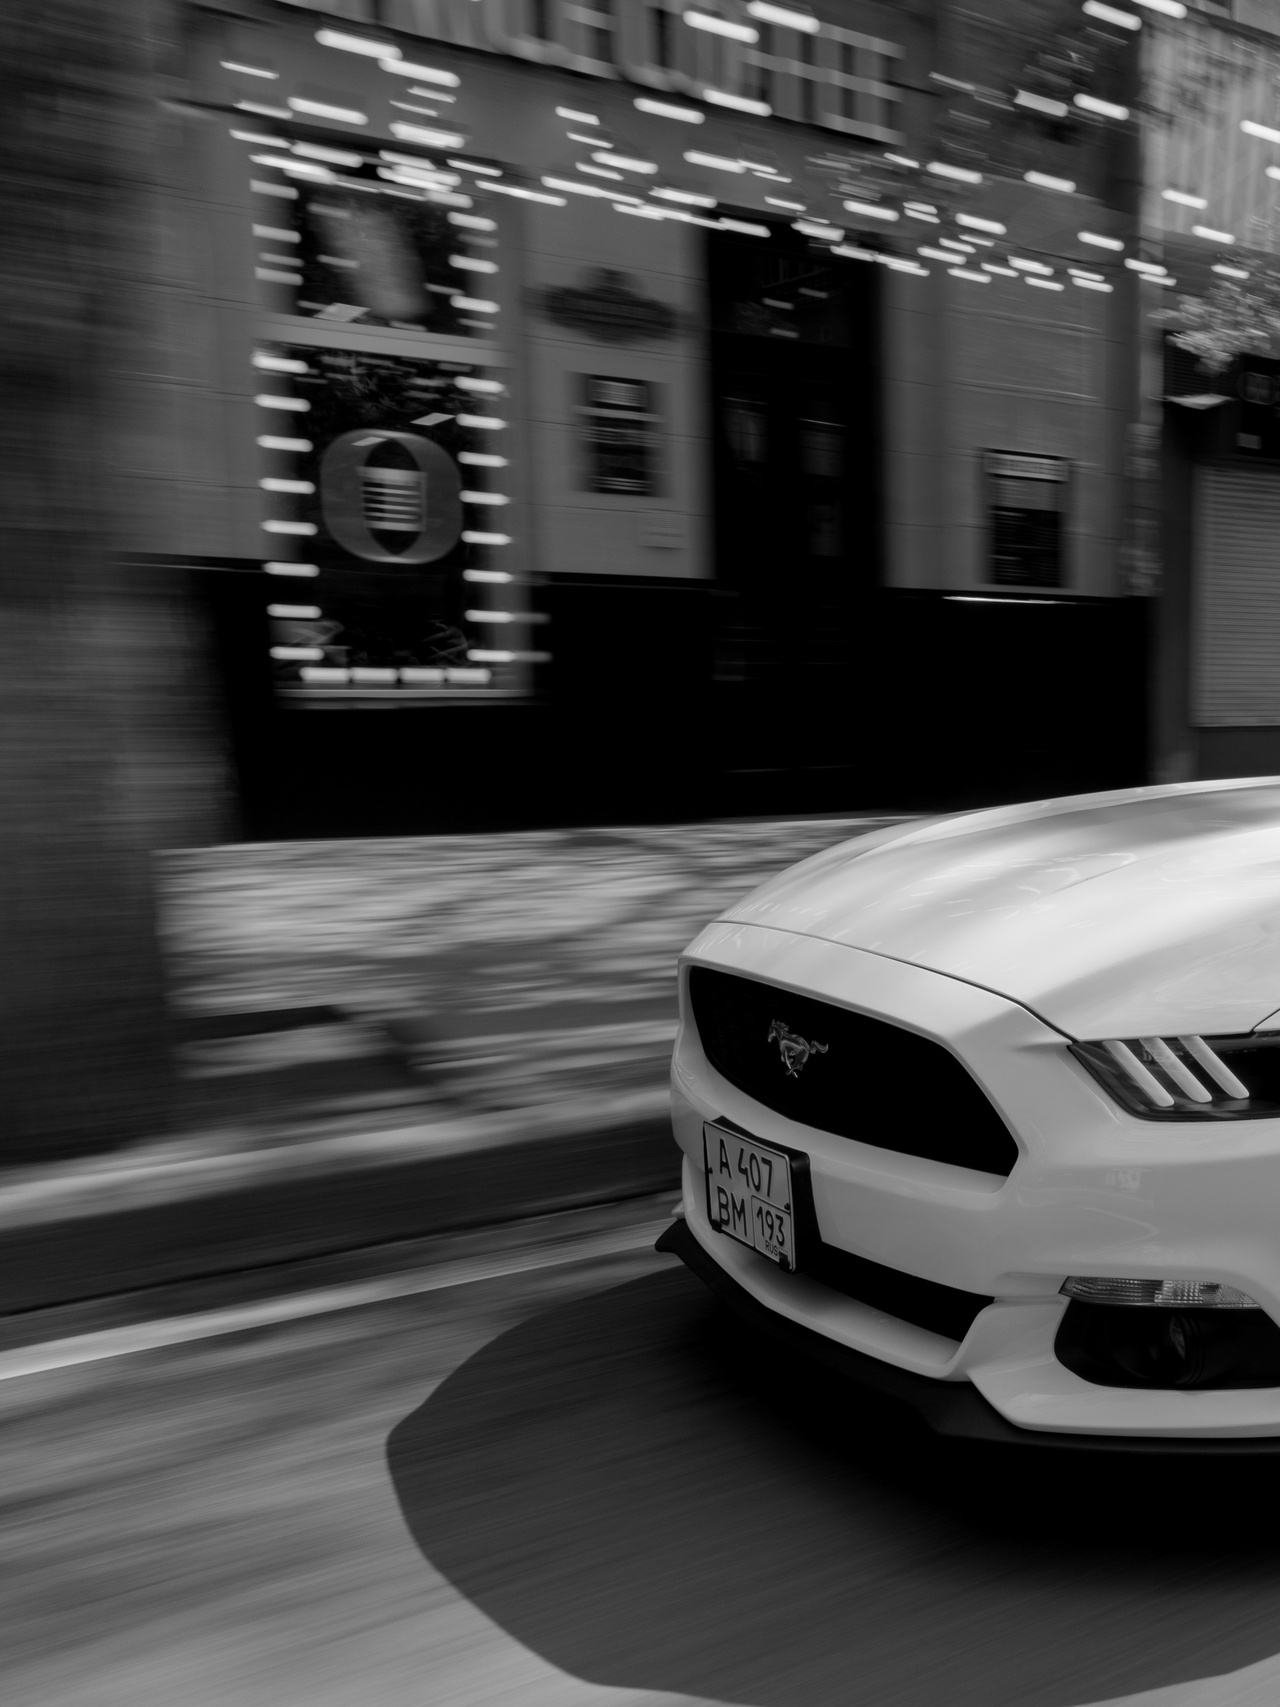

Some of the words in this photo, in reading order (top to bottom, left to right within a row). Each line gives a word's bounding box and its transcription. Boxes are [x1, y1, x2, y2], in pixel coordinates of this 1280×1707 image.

[720, 1138, 731, 1179] A
[738, 1148, 773, 1198] 407
[718, 1186, 748, 1236] BM
[757, 1206, 784, 1246] 193
[765, 1240, 778, 1256] RUS
